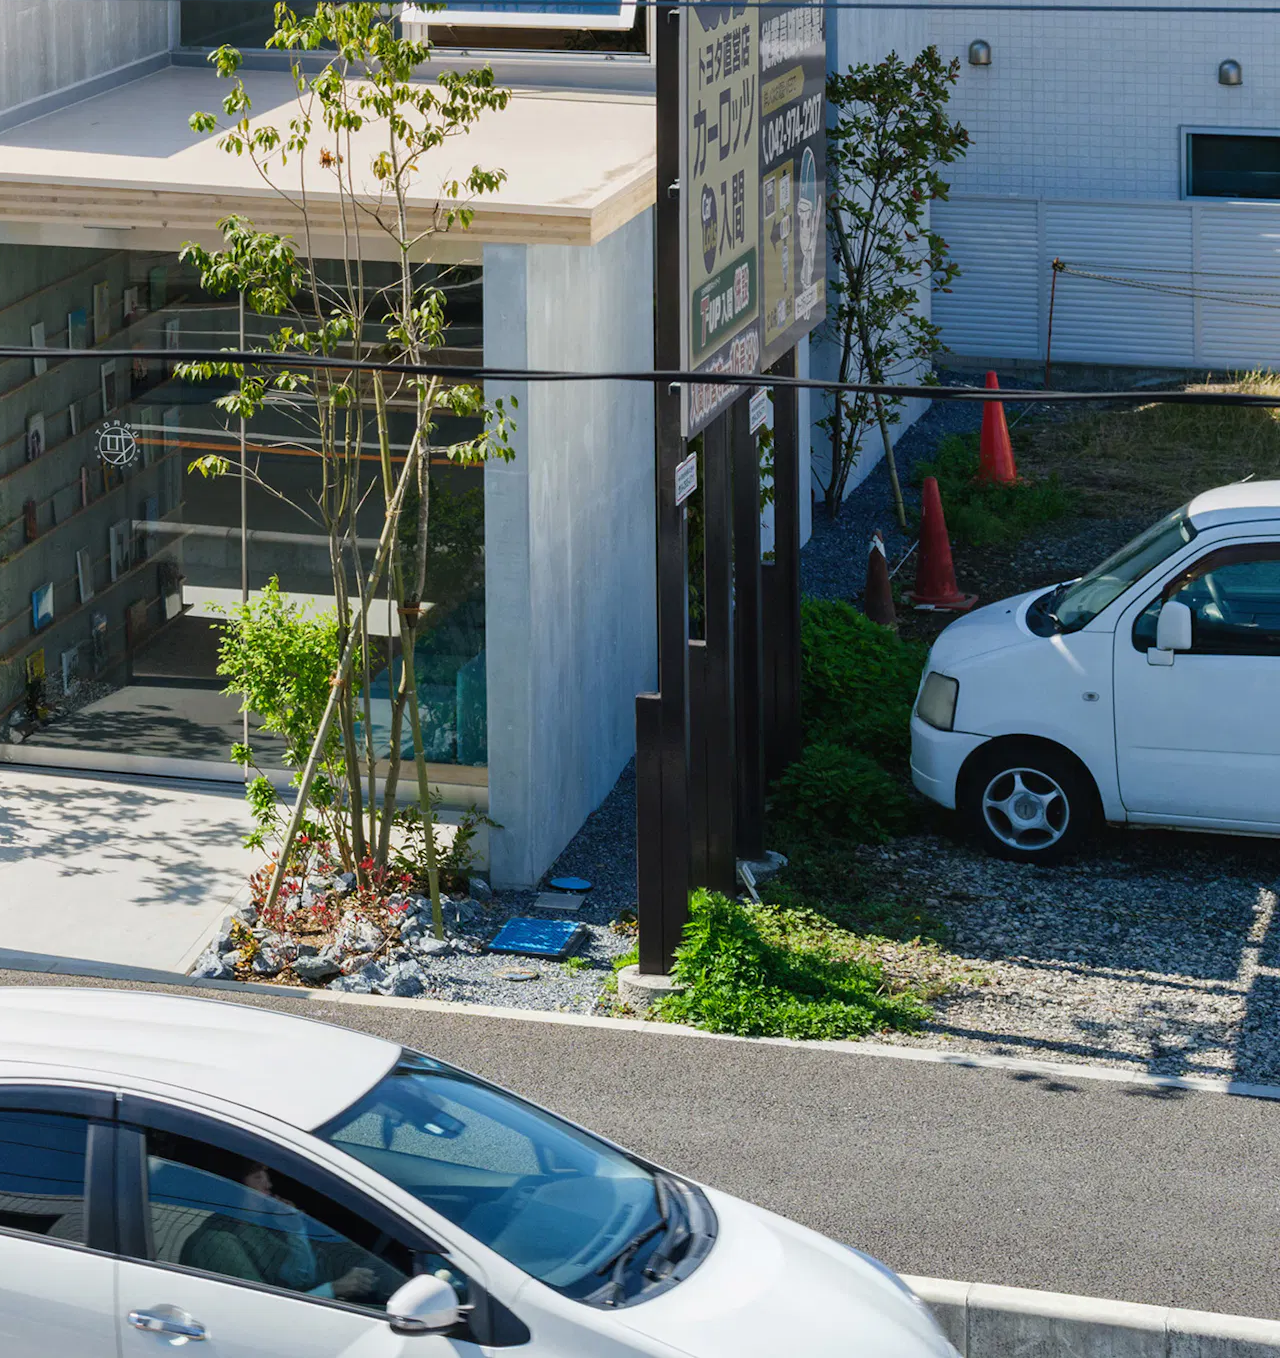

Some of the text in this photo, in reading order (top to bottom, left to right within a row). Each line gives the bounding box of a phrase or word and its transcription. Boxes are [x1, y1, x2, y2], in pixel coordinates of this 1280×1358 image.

[698, 23, 750, 91] トヨタ直営店
[693, 74, 756, 181] カーロッツ
[768, 92, 822, 162] 042-974-2207
[702, 193, 712, 222] Car
[719, 169, 745, 256] 入間
